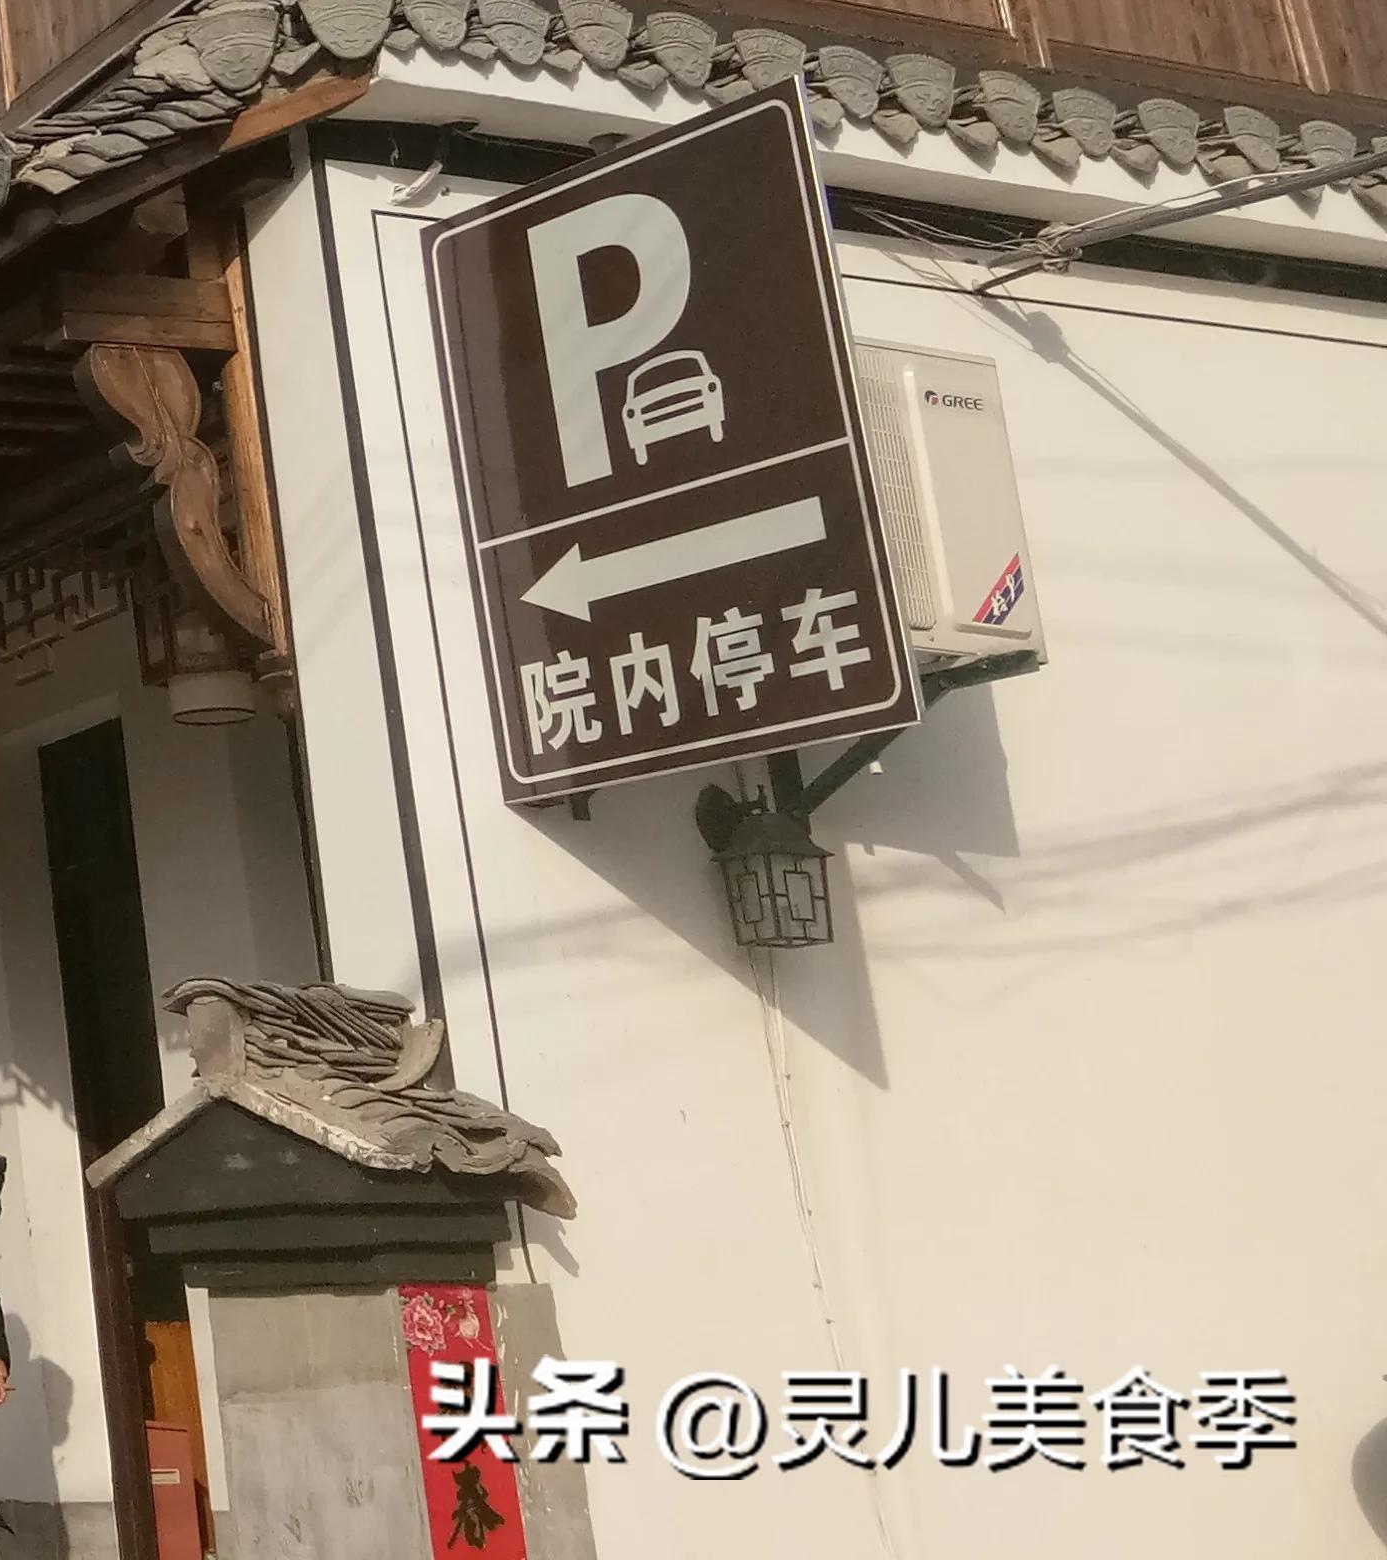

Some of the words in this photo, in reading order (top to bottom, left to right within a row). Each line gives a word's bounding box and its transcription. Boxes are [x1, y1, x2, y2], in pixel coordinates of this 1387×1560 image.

[526, 193, 691, 488] P
[942, 394, 983, 411] GREE
[519, 587, 872, 755] 院内停车
